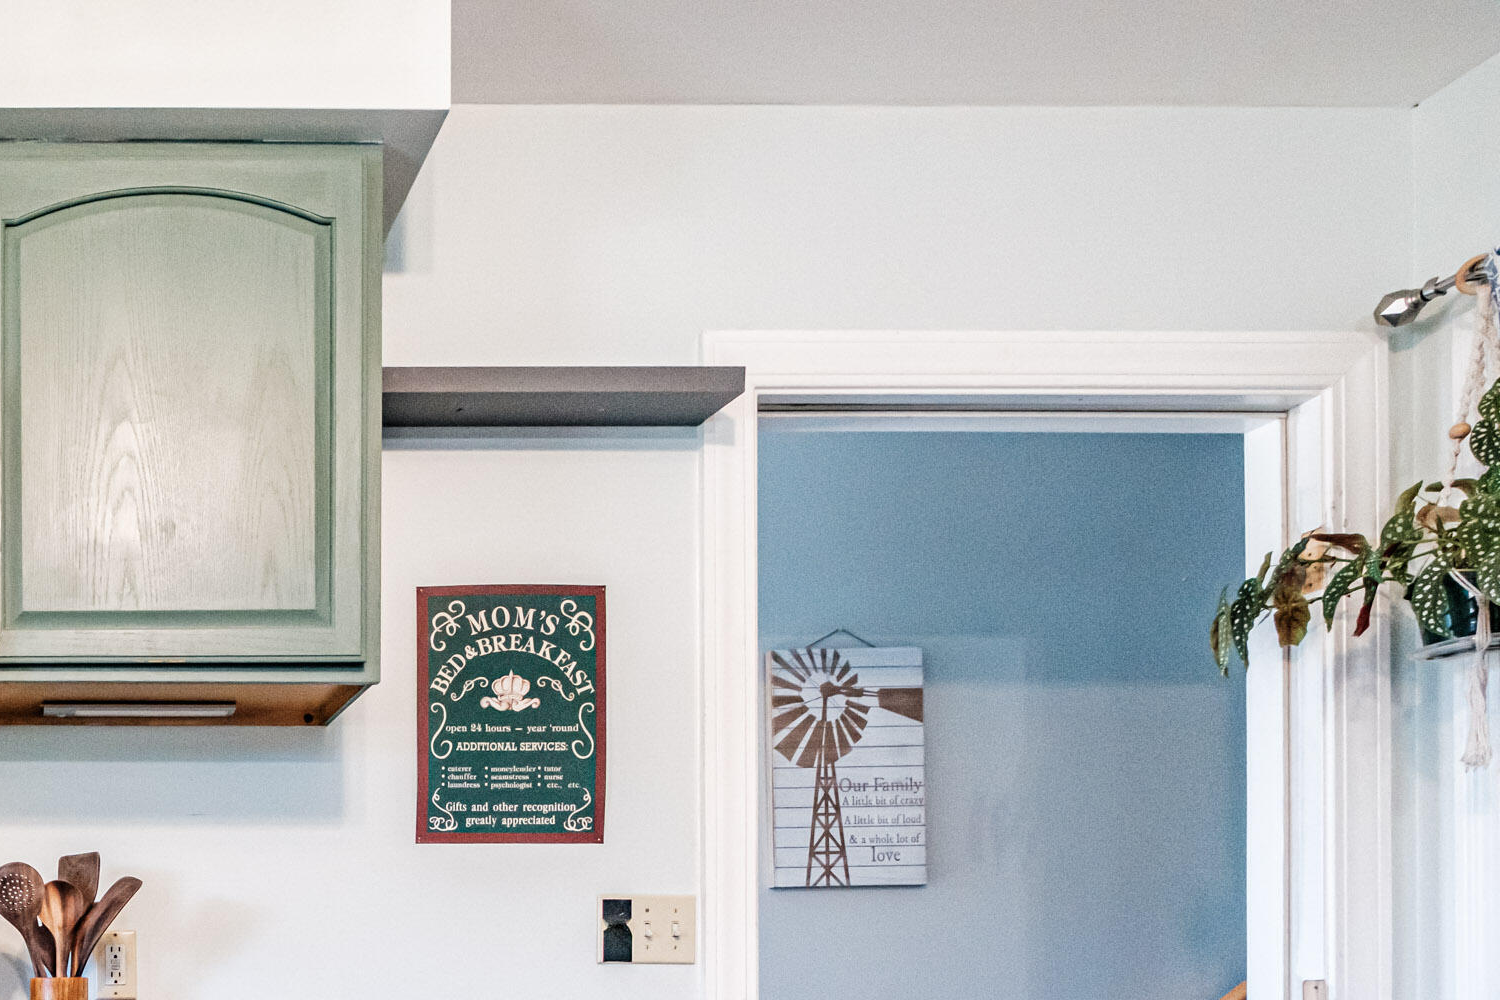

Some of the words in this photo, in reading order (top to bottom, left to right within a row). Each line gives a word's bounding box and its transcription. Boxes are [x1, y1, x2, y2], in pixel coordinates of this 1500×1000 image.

[465, 606, 560, 636] MOM'S
[446, 725, 467, 734] open
[470, 723, 482, 732] 24
[485, 724, 511, 732] hours
[527, 725, 547, 734] year
[456, 742, 517, 751] ADDITIONAL
[520, 742, 569, 751] SERVICES:
[490, 782, 533, 790] psychologist
[840, 777, 869, 792] Our
[874, 777, 922, 794] Family
[842, 796, 849, 805] A
[852, 796, 872, 805] little
[875, 796, 886, 805] bit
[889, 795, 899, 805] of
[900, 797, 924, 806] crazy
[445, 802, 467, 812] Gifts
[471, 802, 489, 812] and
[492, 802, 519, 812] other
[523, 802, 577, 814] recognition
[466, 816, 497, 828] greatly
[501, 816, 556, 828] appreciated
[844, 816, 851, 825] A
[854, 815, 874, 825] little
[877, 815, 888, 824] bit
[891, 814, 902, 824] of
[903, 814, 922, 824] loud
[869, 834, 893, 844] whole
[896, 834, 909, 843] lot
[911, 833, 921, 843] of
[871, 846, 901, 862] love
